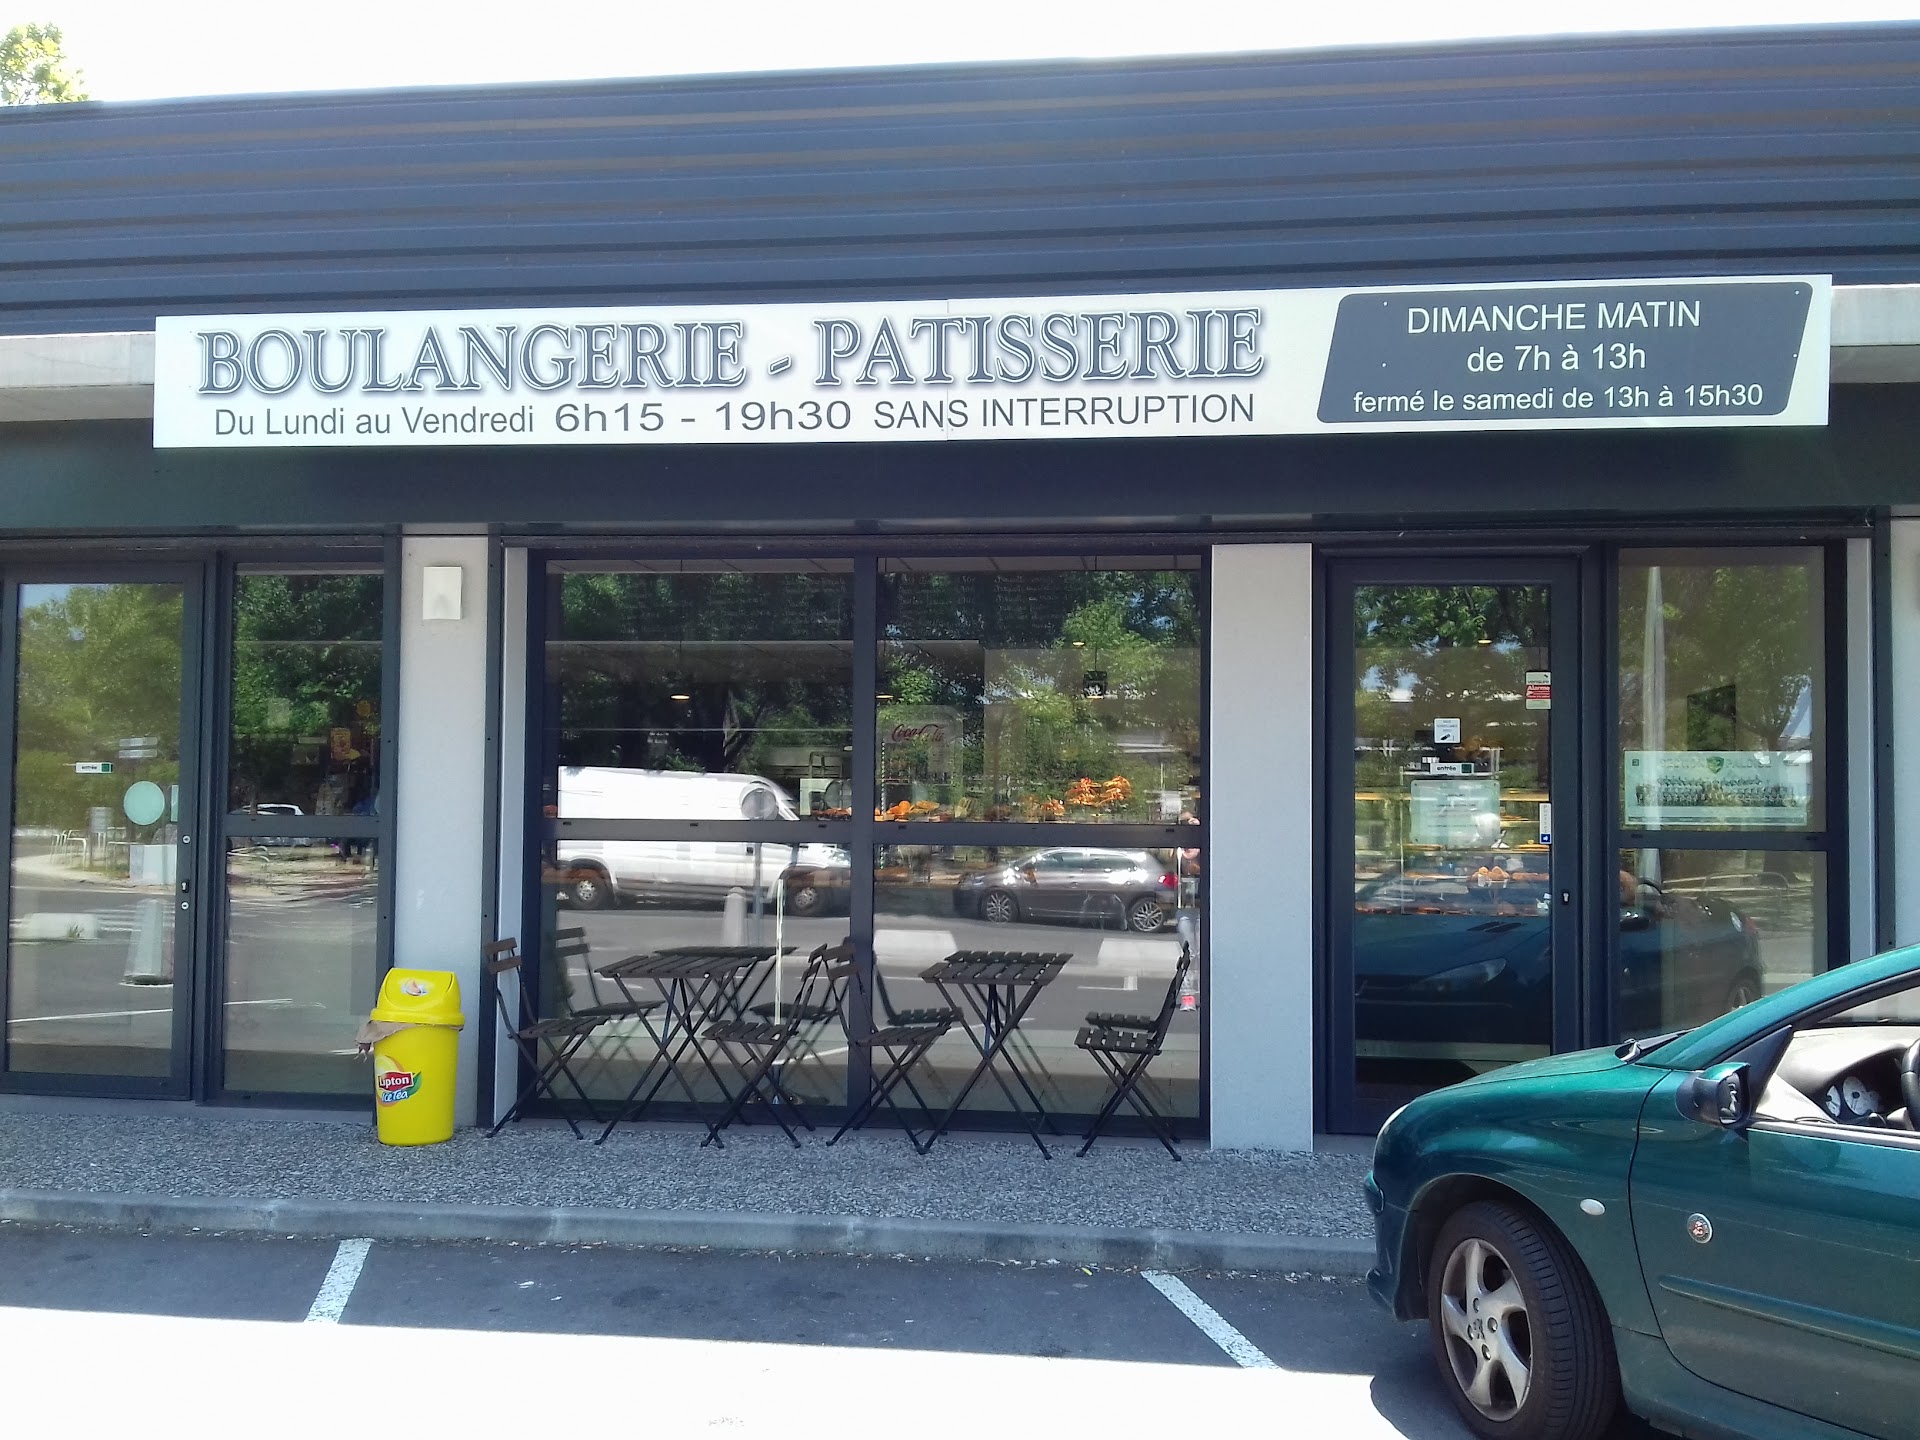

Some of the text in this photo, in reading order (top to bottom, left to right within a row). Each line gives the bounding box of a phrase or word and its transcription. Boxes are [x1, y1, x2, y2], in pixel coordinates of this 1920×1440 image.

[1408, 300, 1700, 334] DIMANCHE MATIN
[197, 322, 748, 396] BOULANGERIE
[813, 308, 1264, 386] PATISSERIE
[1467, 342, 1646, 373] de 7h à 13h
[1353, 383, 1763, 413] fermé le samedi de 13h à 15h30
[215, 409, 254, 436] Du
[266, 407, 344, 435] Lundi
[355, 414, 390, 434] au
[401, 405, 533, 434] Vendredi
[555, 402, 664, 432] 6h15
[715, 400, 851, 431] 19h30
[873, 400, 969, 429] SANS
[982, 393, 1254, 427] INTERRUPTION
[379, 1077, 410, 1089] Lipton
